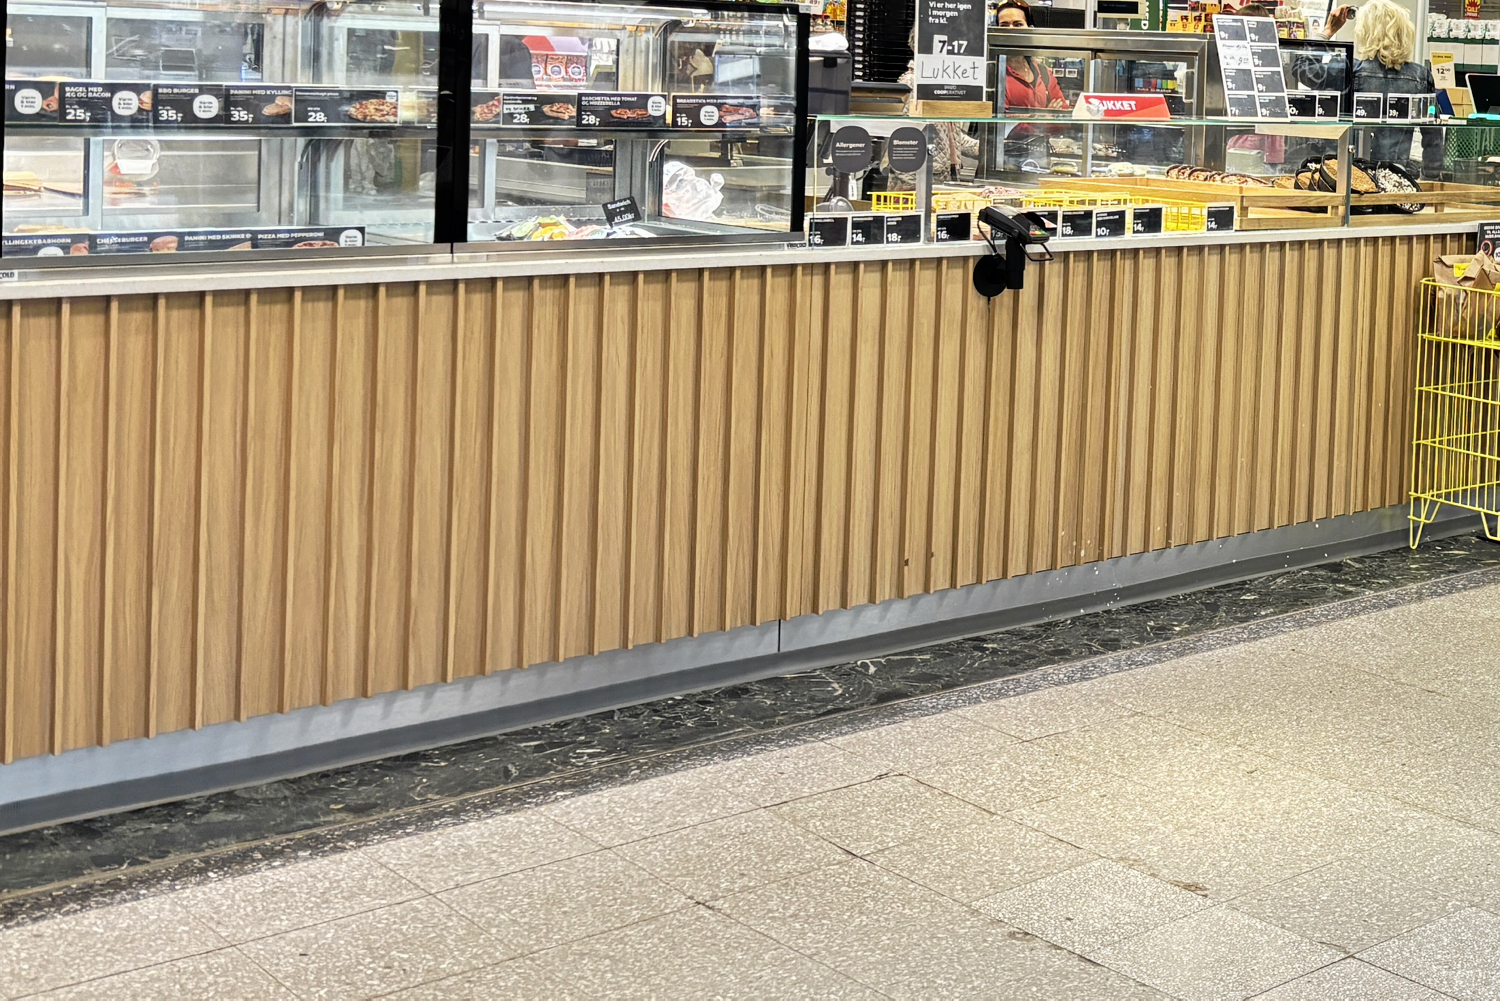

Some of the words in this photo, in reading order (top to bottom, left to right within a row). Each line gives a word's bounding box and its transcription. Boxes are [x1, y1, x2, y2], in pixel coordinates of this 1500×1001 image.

[945, 1, 956, 9] her
[957, 2, 972, 10] igen
[932, 10, 959, 18] morgen
[938, 40, 968, 54] 7-17
[1099, 100, 1137, 111] UKKET
